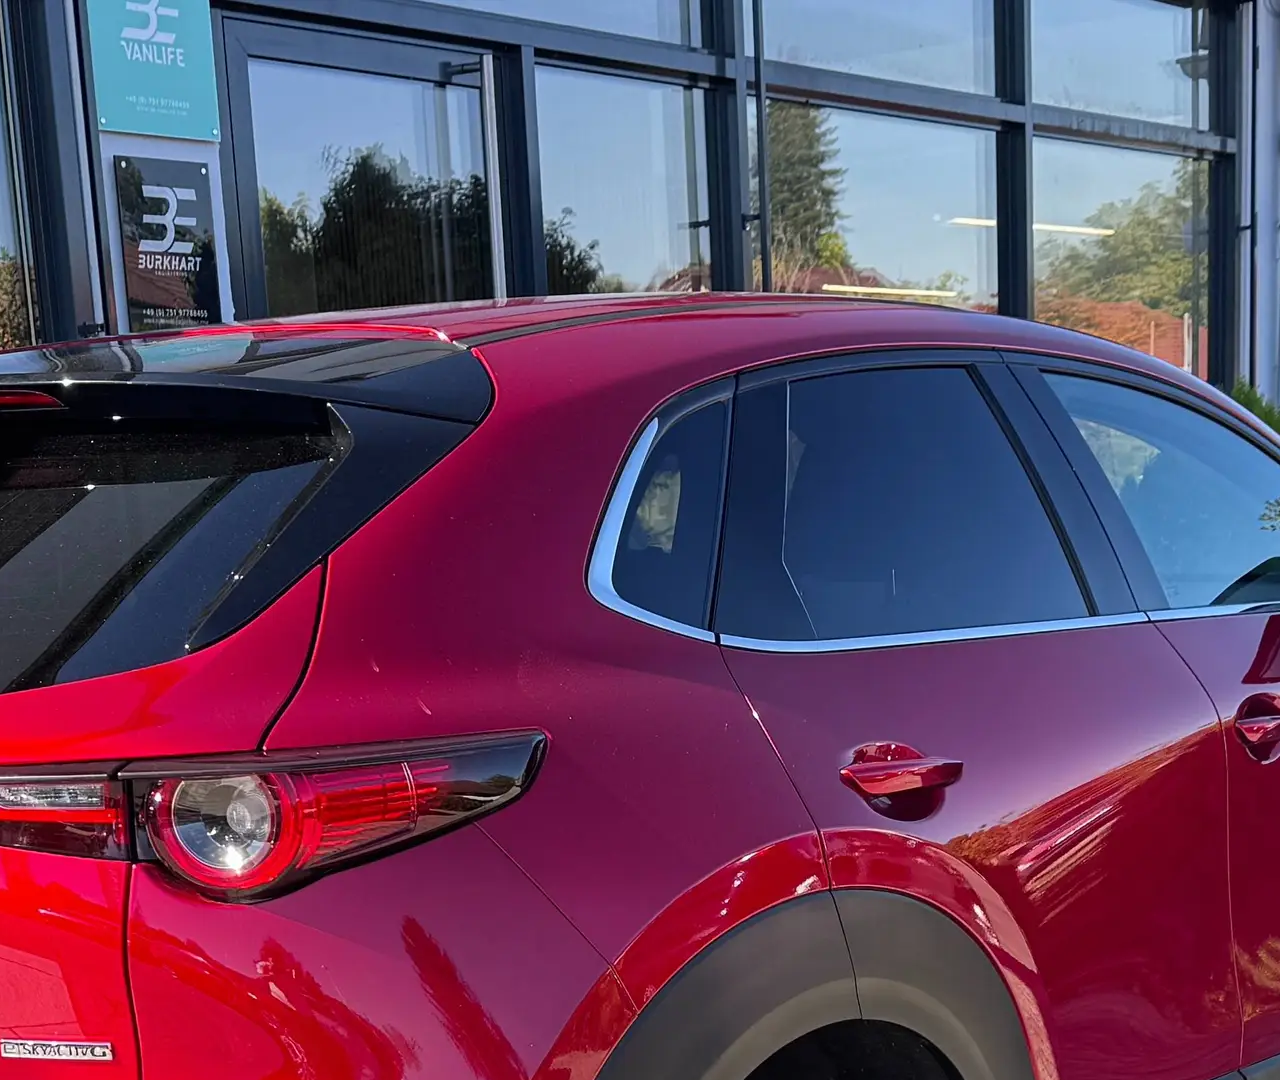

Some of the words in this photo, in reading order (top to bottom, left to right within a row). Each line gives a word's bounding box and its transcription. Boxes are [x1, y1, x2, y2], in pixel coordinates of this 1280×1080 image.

[120, 40, 186, 67] VANLIFE
[138, 254, 202, 271] BURKHART
[142, 308, 154, 316] +49
[166, 308, 177, 317] 751
